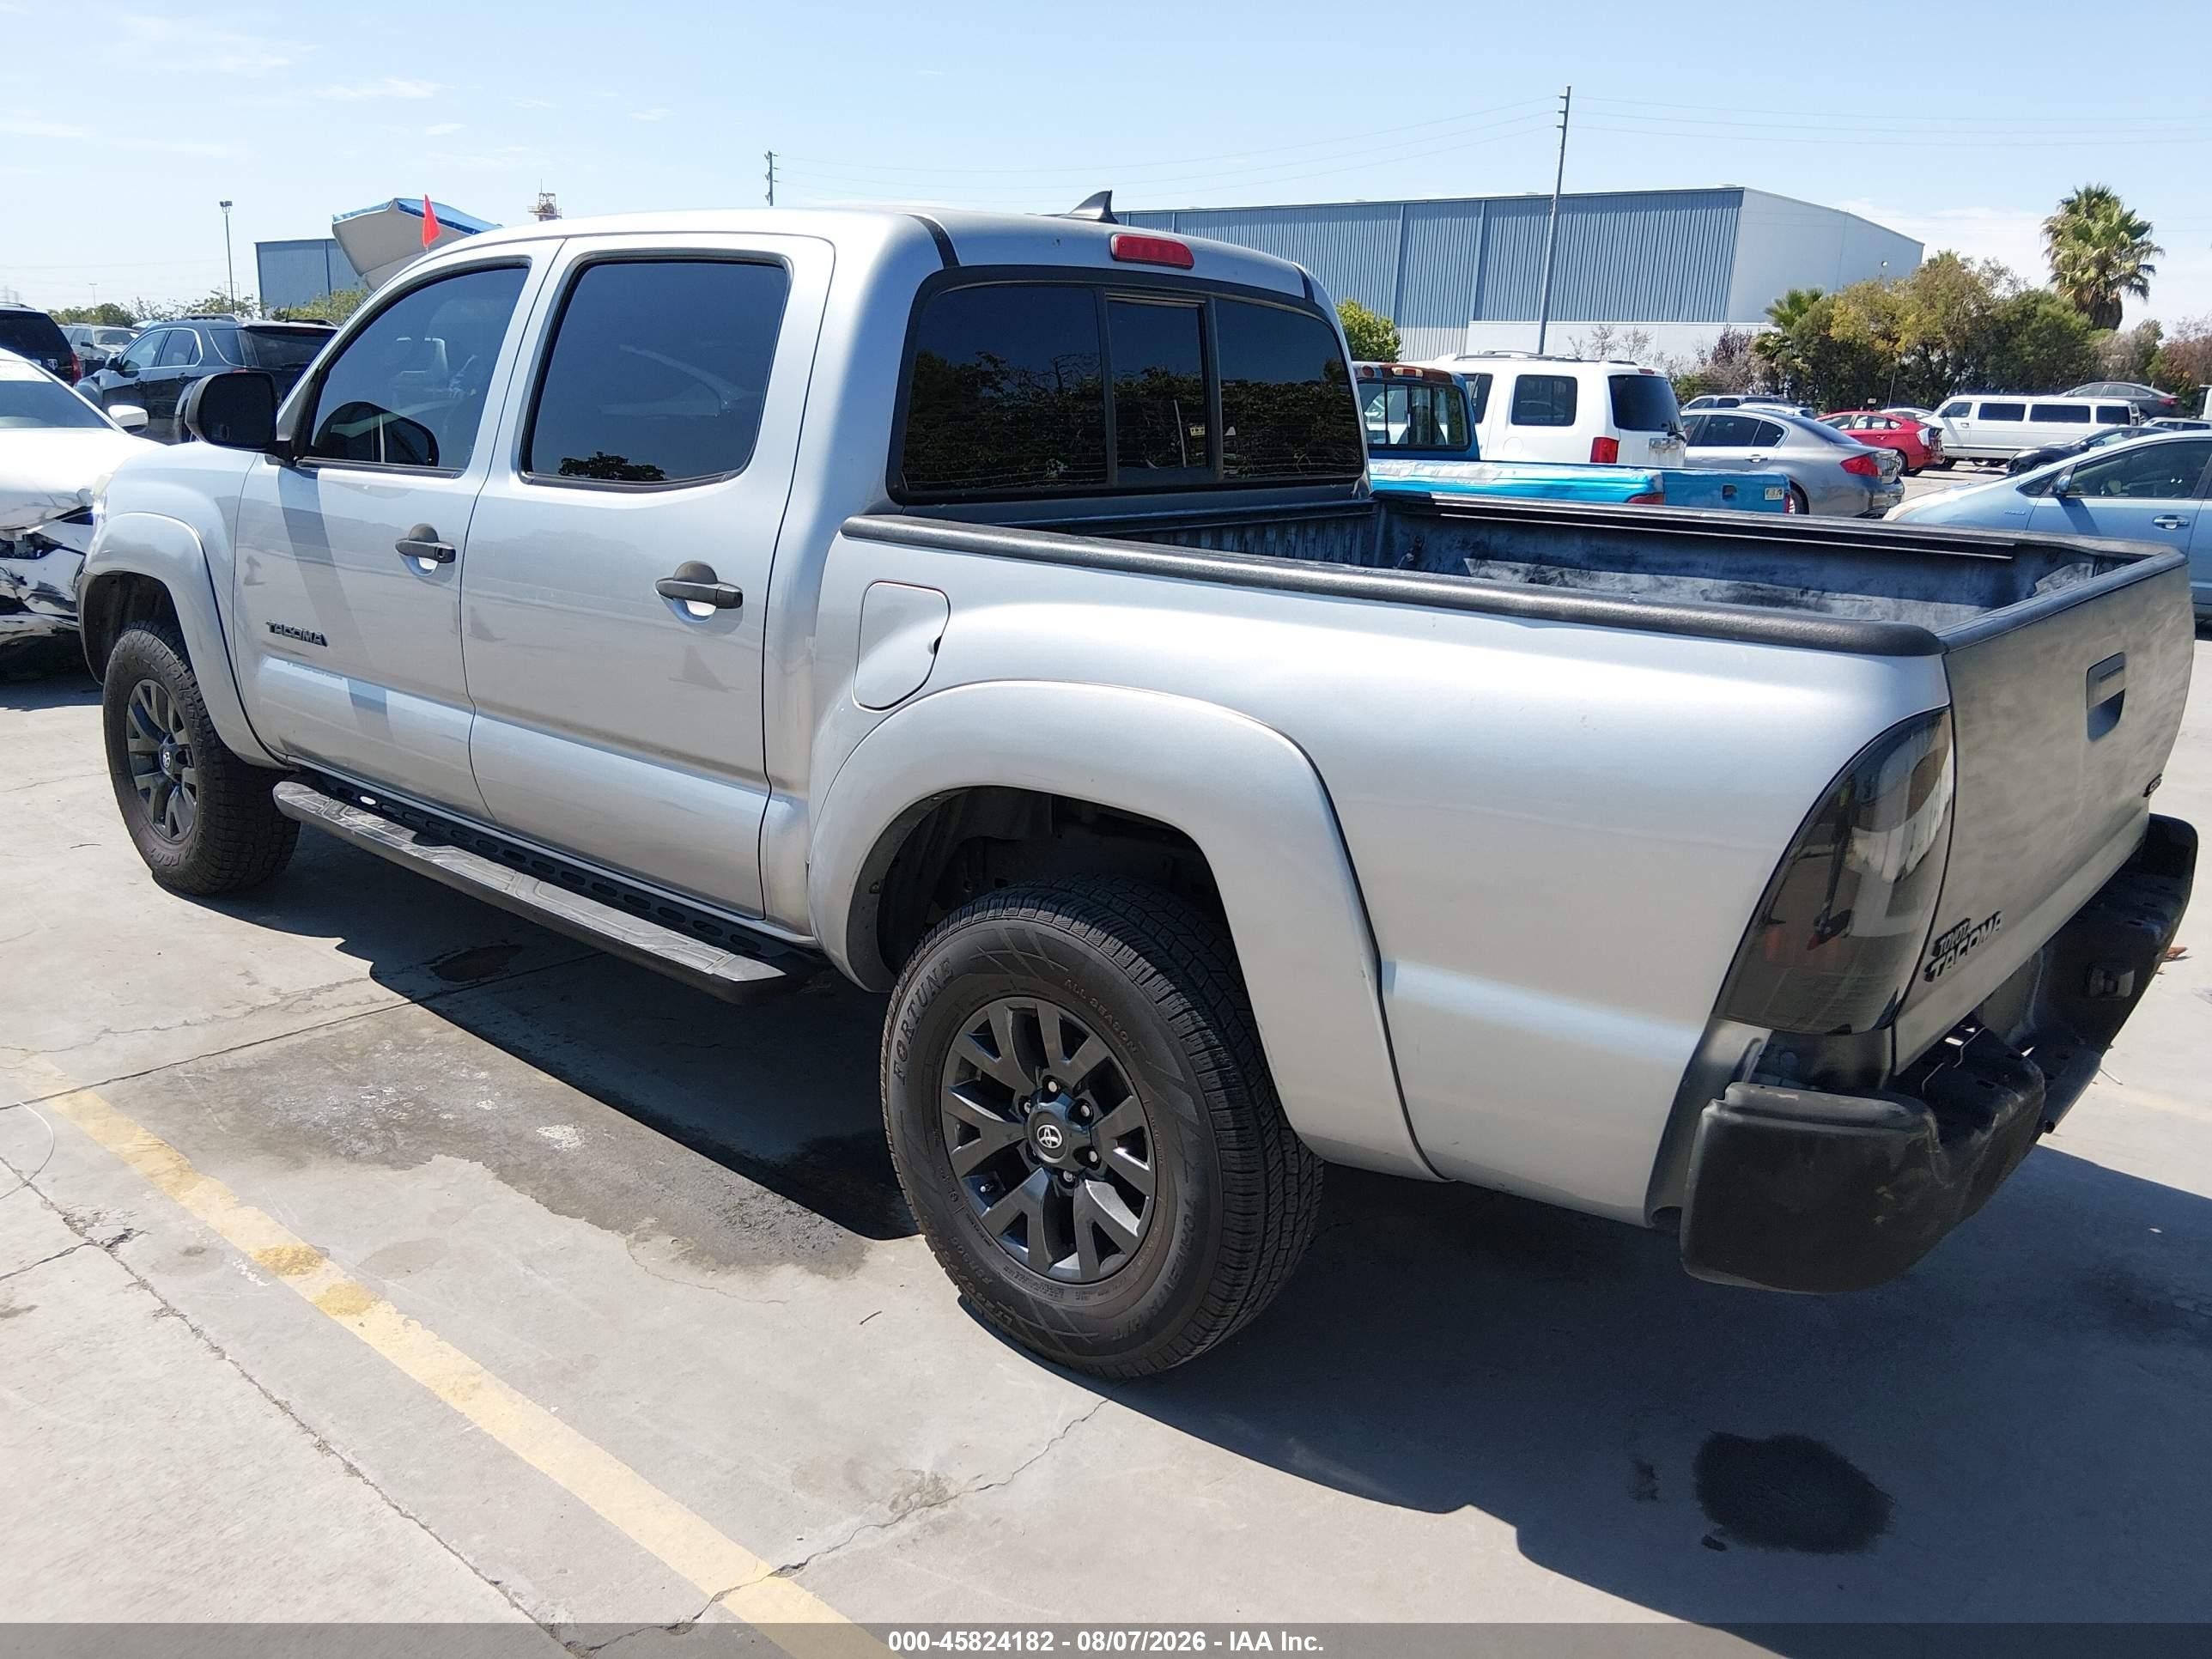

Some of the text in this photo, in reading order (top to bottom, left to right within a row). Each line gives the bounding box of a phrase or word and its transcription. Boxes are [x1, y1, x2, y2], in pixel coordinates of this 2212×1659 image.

[265, 620, 328, 647] TACOMA
[1923, 910, 2002, 983] TACOMA
[1065, 979, 1086, 1000] ALL
[893, 957, 954, 1086] FORTUNE
